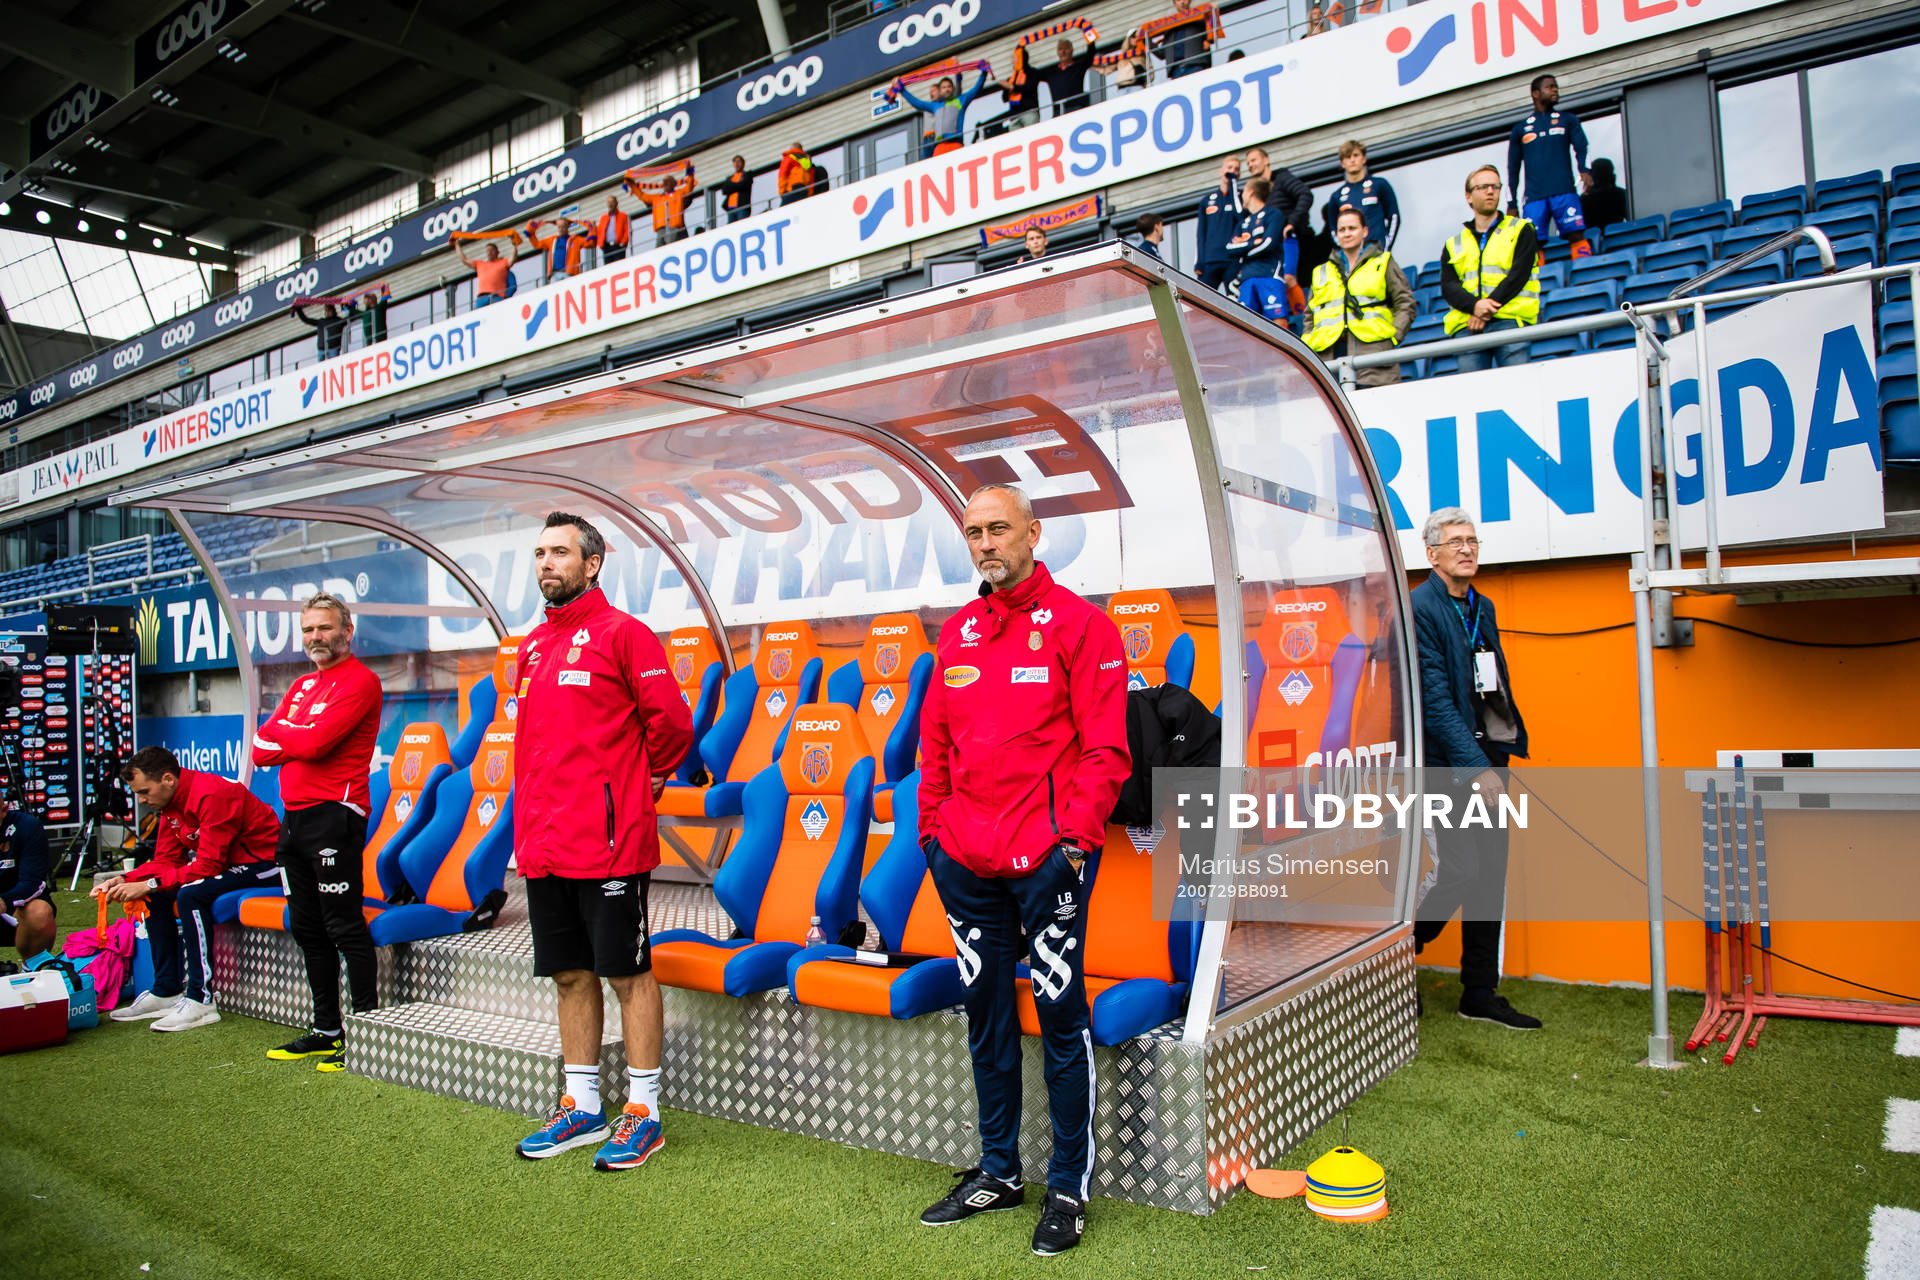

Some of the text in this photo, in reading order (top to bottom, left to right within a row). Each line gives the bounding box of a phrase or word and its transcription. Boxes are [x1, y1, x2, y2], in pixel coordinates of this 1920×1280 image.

[878, 0, 982, 54] coop
[736, 55, 824, 112] coop
[615, 110, 690, 161] coop
[904, 63, 1284, 228] INTERSPORT
[512, 158, 577, 204] coop
[423, 199, 479, 241] coop
[344, 236, 393, 273] coop
[275, 267, 319, 301] coop
[554, 218, 791, 333] INTERSPORT
[214, 296, 253, 327] coop
[161, 320, 195, 349] coop
[113, 343, 144, 370] coop
[322, 320, 481, 404] INTERSPORT
[69, 364, 97, 389] coop
[30, 382, 56, 406] coop
[158, 389, 272, 453] INTERSPORT
[32, 443, 119, 496] JEAN PAUL
[1113, 603, 1160, 615] RECARO
[1275, 601, 1327, 613] RECARO
[671, 637, 699, 646] RECARO
[766, 632, 799, 642] RECARO
[872, 625, 908, 636] RECARO
[640, 668, 667, 678] umbro
[403, 735, 431, 744] RECARO
[795, 720, 840, 732] RECARO
[804, 750, 829, 783] AFK
[322, 857, 335, 866] FM
[1012, 855, 1029, 870] LB
[1057, 891, 1073, 906] LB
[71, 1003, 91, 1017] DOC
[1056, 1192, 1079, 1207] umbro
